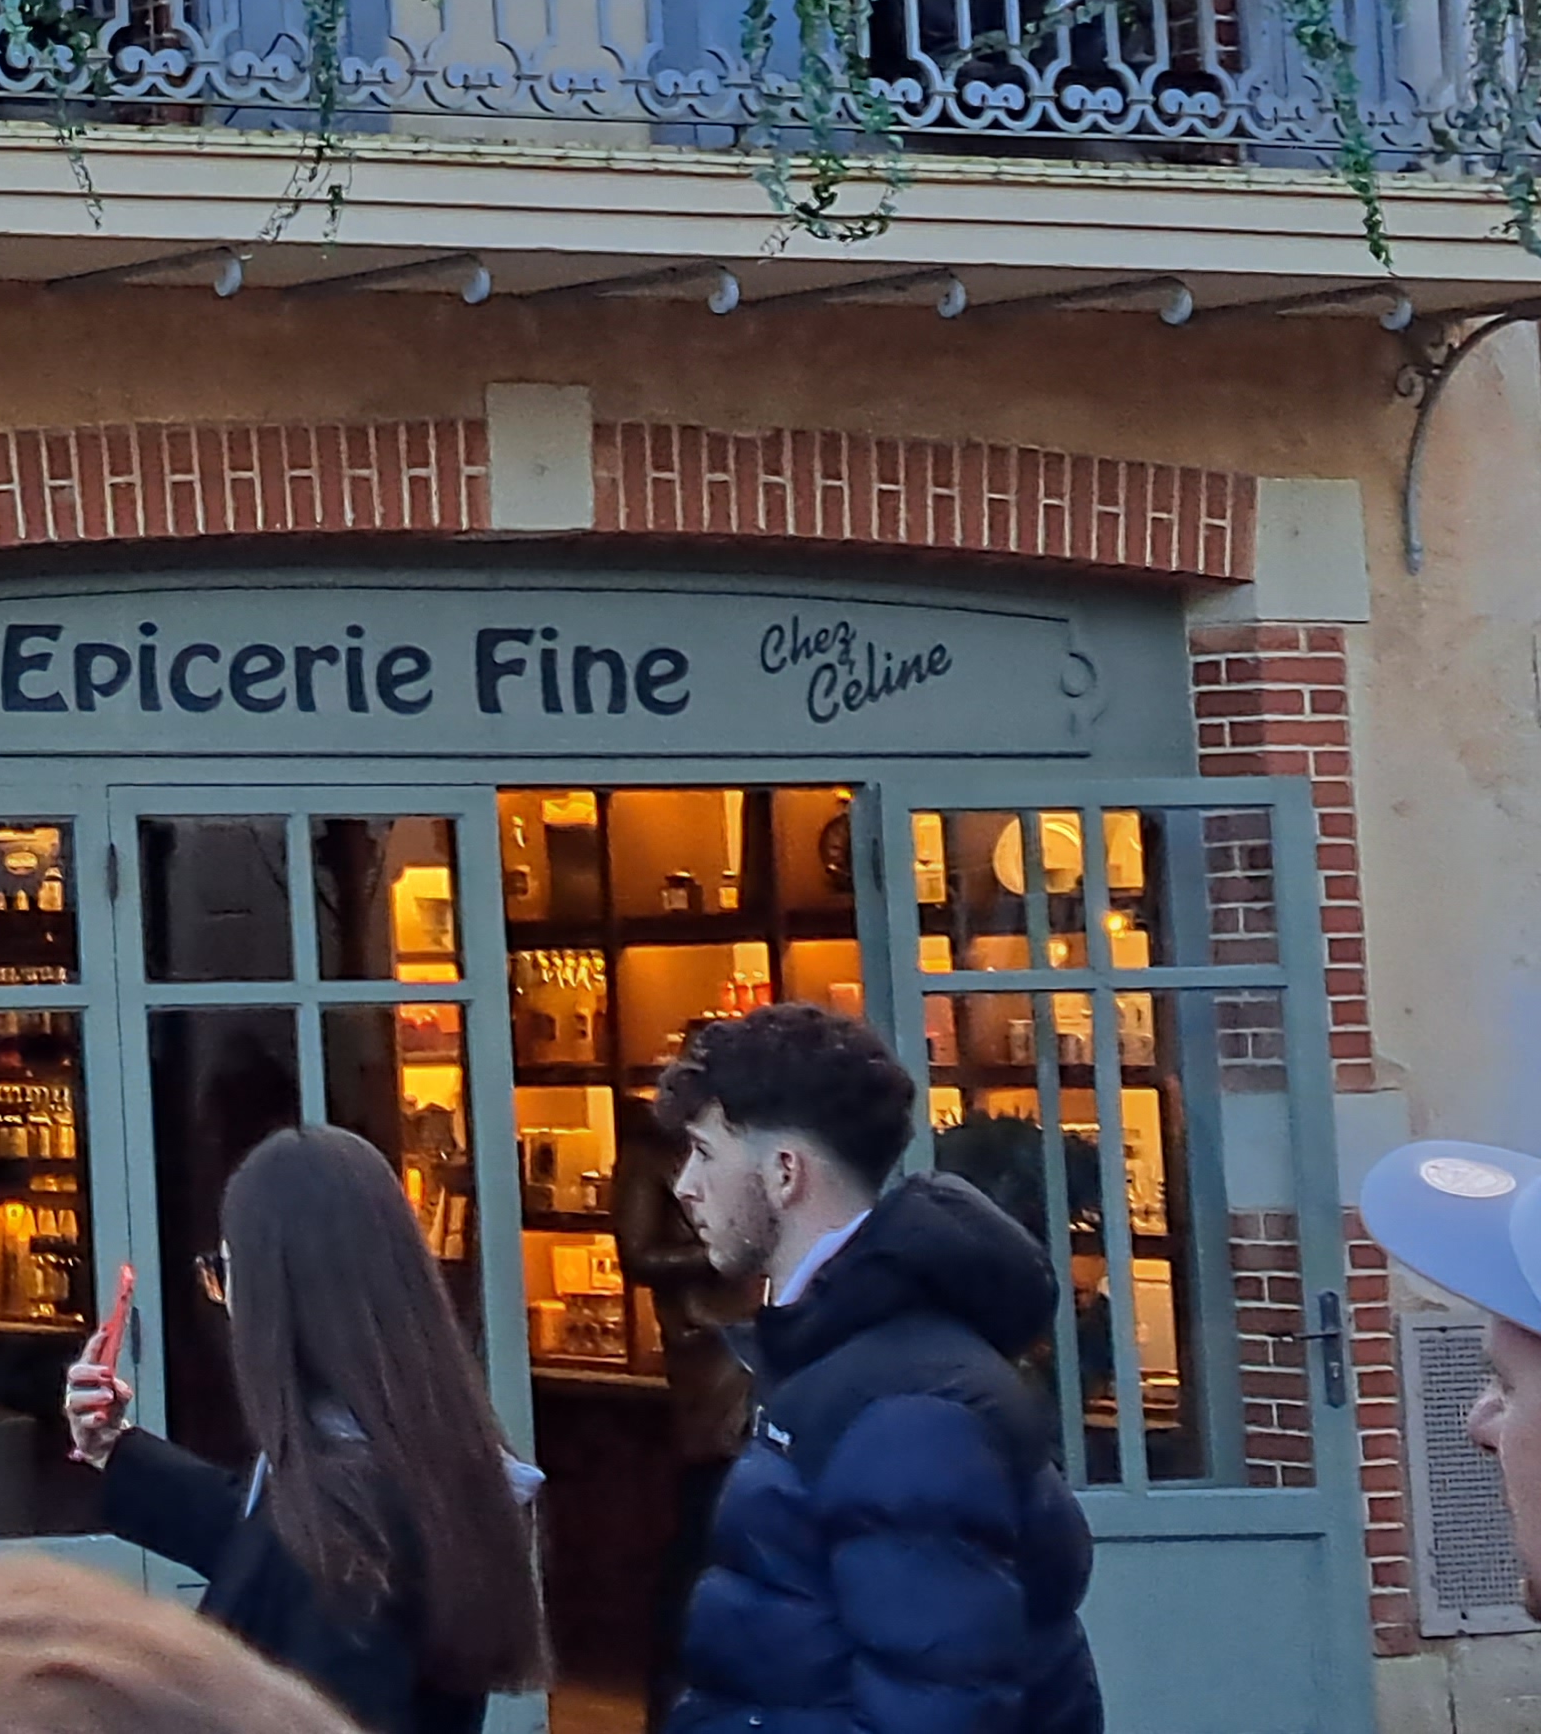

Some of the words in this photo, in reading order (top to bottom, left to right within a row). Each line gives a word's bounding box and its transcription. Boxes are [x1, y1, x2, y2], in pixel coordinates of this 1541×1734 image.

[1, 621, 434, 715] Epicerie
[475, 626, 691, 716] Fine
[759, 615, 857, 675] Chez
